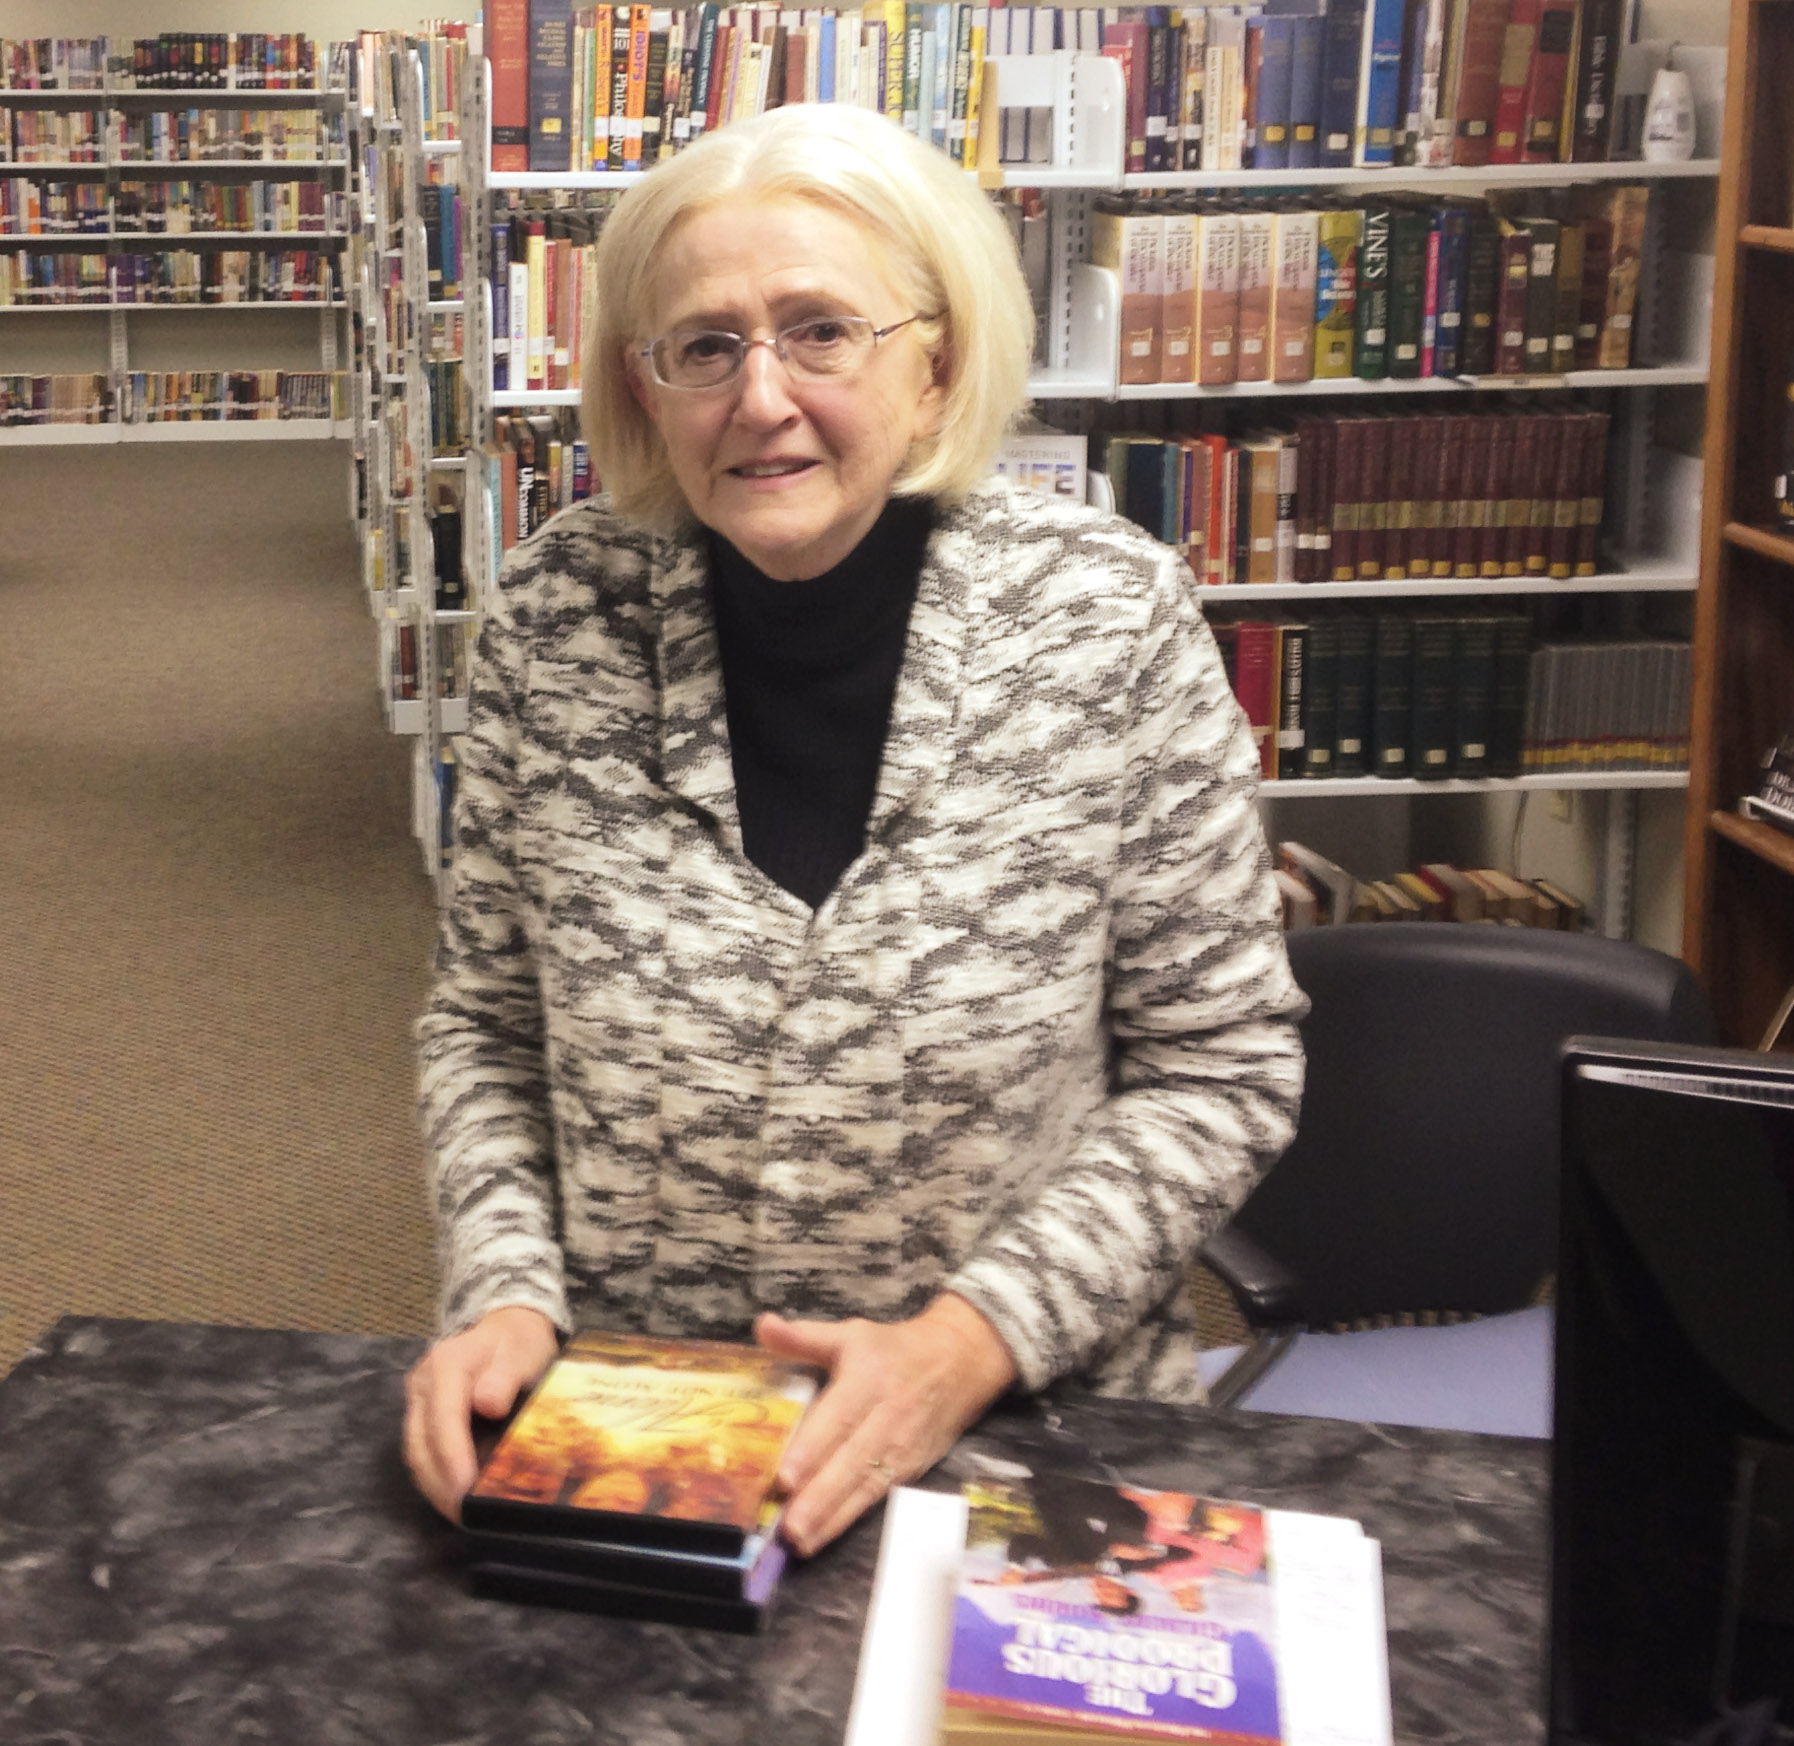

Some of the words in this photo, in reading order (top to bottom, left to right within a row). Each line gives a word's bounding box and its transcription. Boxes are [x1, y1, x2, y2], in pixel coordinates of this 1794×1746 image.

[907, 28, 922, 79] HUMOR
[609, 72, 628, 157] Philoshy
[1366, 212, 1389, 279] VINE'S
[517, 466, 535, 538] UNCOMMON
[1001, 1641, 1238, 1709] GLORIOUS
[1015, 1620, 1235, 1678] PRODIGAL
[1084, 1683, 1154, 1716] THE
